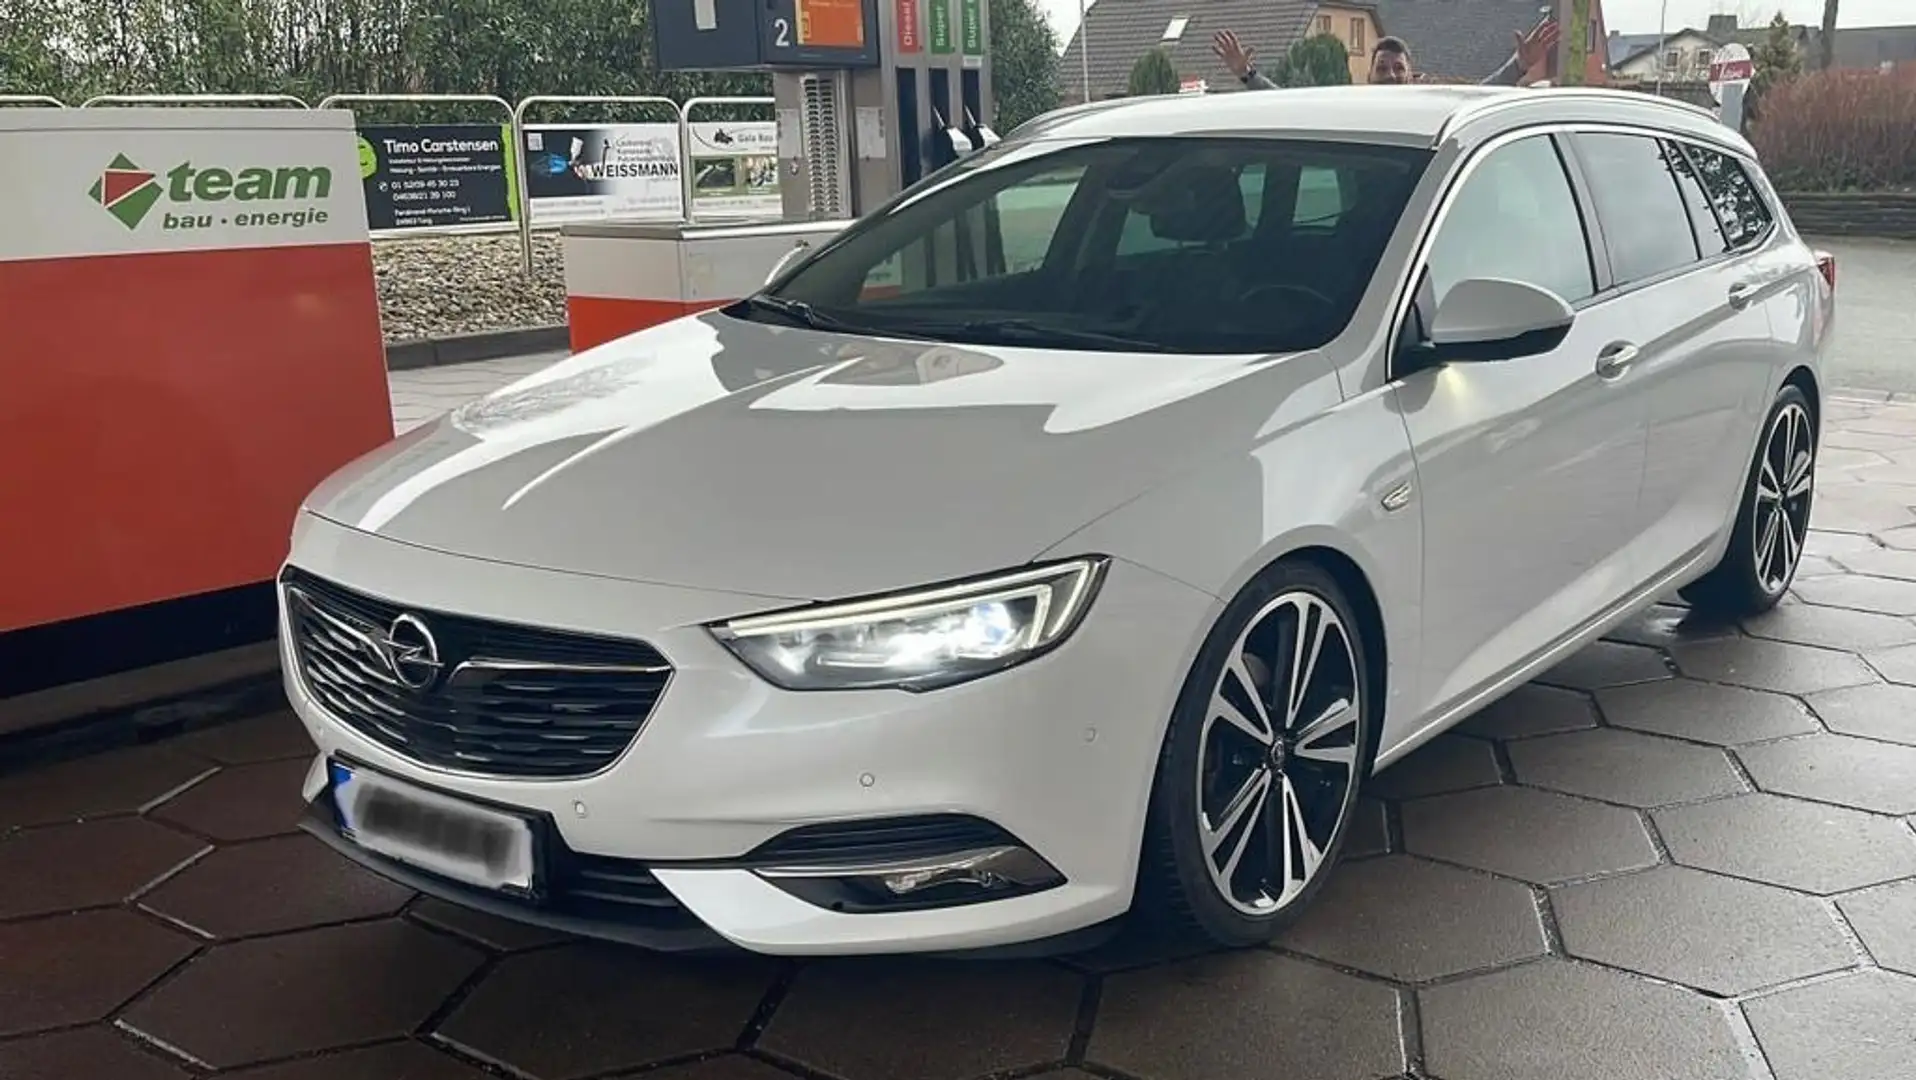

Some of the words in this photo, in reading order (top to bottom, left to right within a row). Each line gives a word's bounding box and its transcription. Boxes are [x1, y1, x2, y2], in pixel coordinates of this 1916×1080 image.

[774, 18, 790, 47] 2
[383, 138, 419, 154] Timo
[420, 138, 499, 153] Carstensen
[591, 162, 679, 178] WEISSMANN
[166, 160, 332, 202] team
[163, 212, 213, 229] bau
[234, 208, 328, 227] energie
